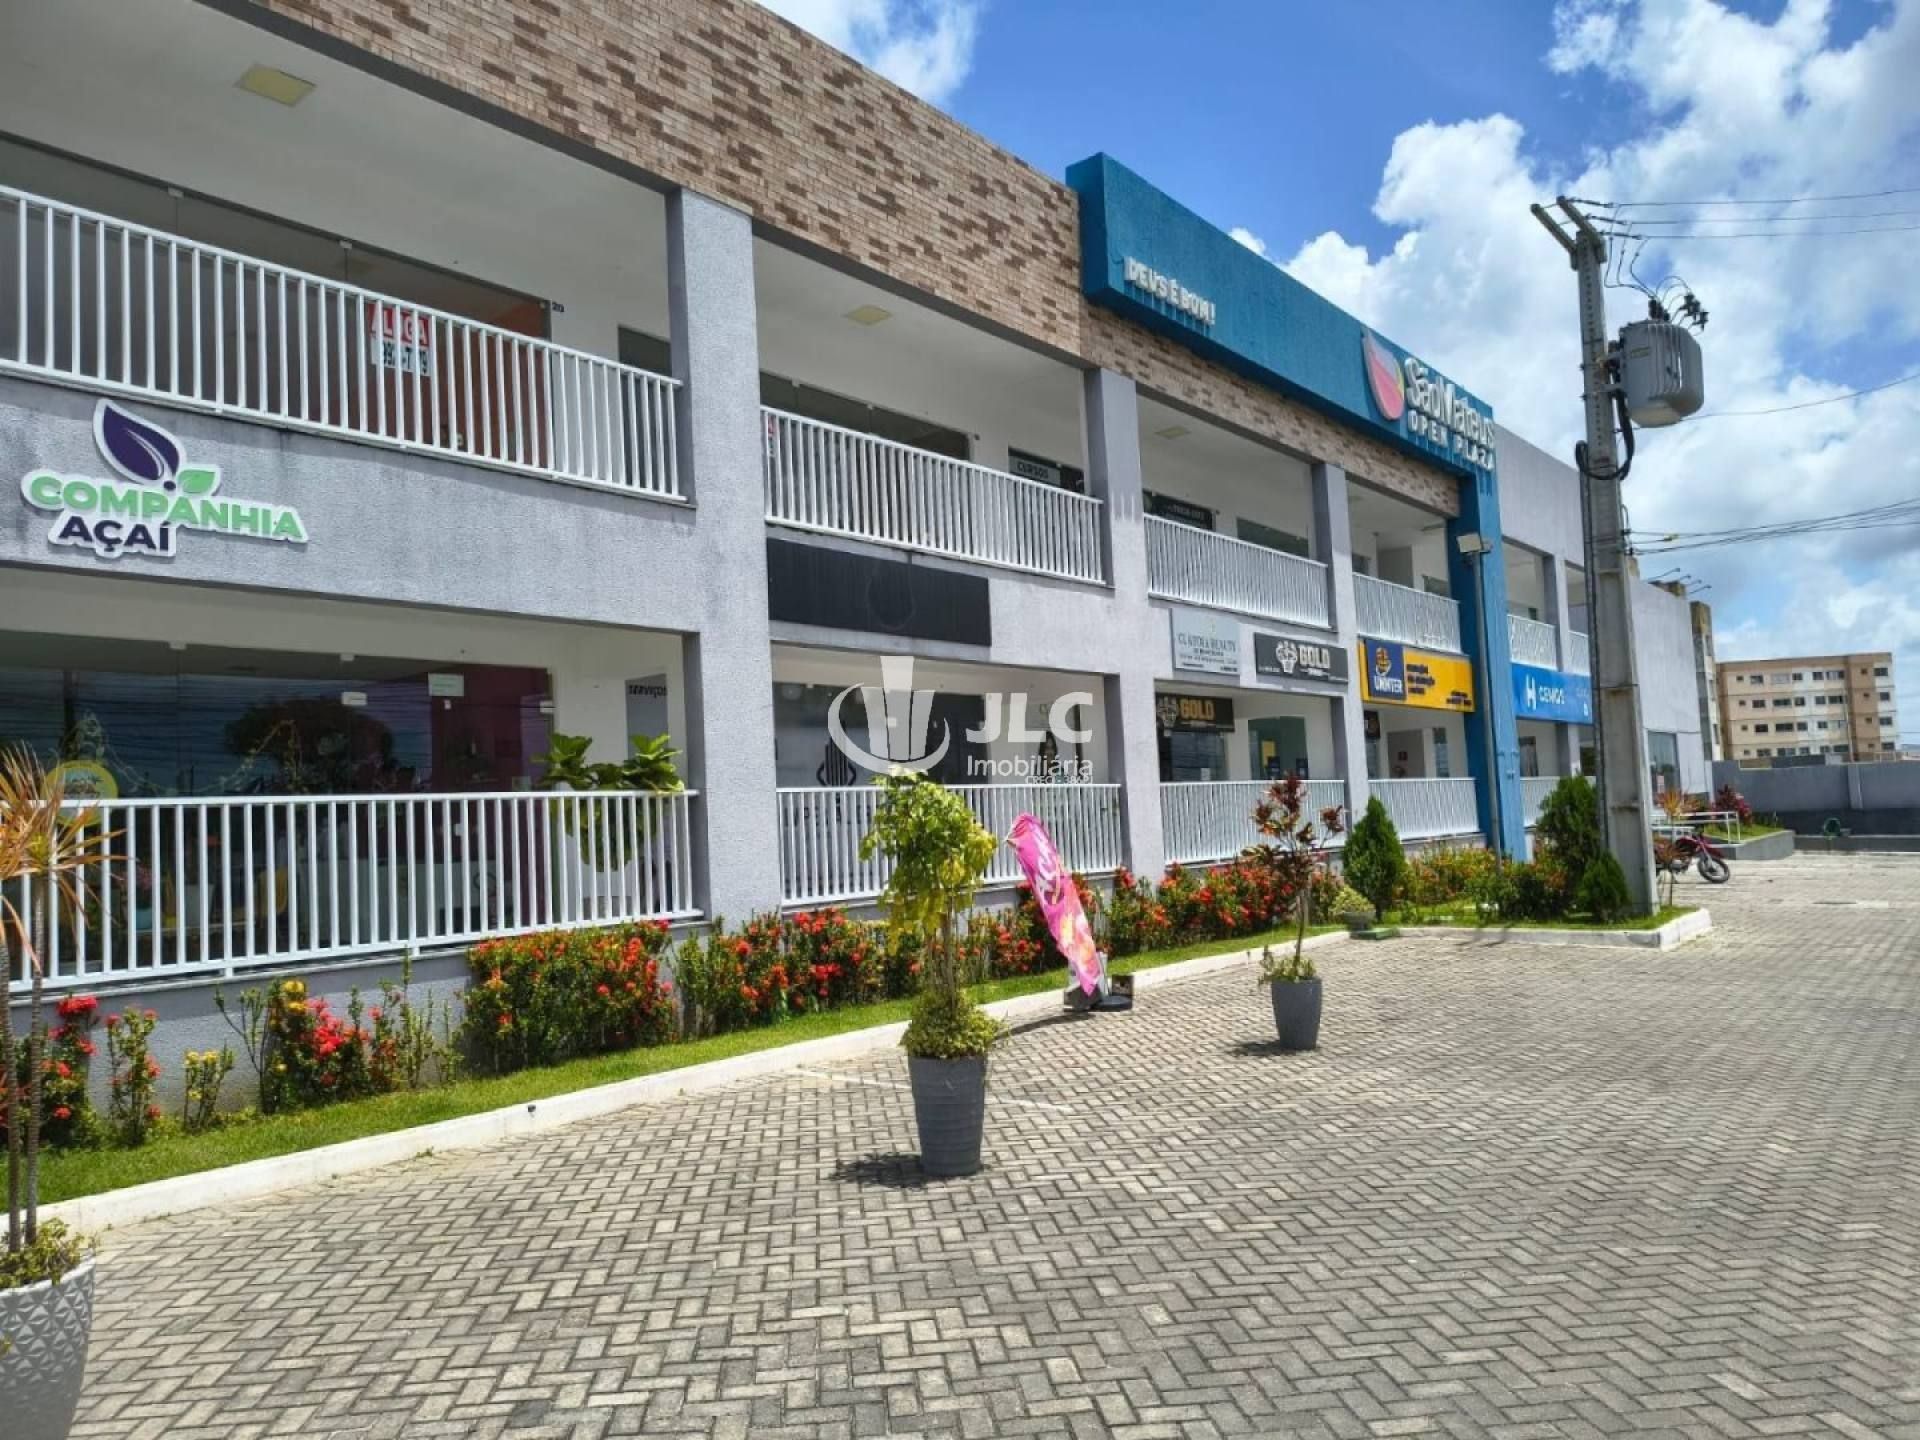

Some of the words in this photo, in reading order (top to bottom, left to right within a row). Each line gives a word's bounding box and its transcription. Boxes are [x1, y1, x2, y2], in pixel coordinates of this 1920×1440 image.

[1407, 410, 1448, 448] OPEN
[1453, 434, 1494, 471] PLAZA
[1017, 461, 1048, 479] CURSOS
[30, 475, 303, 539] COMPANHIA
[58, 516, 170, 552] AÇAÍ
[1299, 644, 1330, 669] GOLD
[1180, 699, 1215, 721] GOLD
